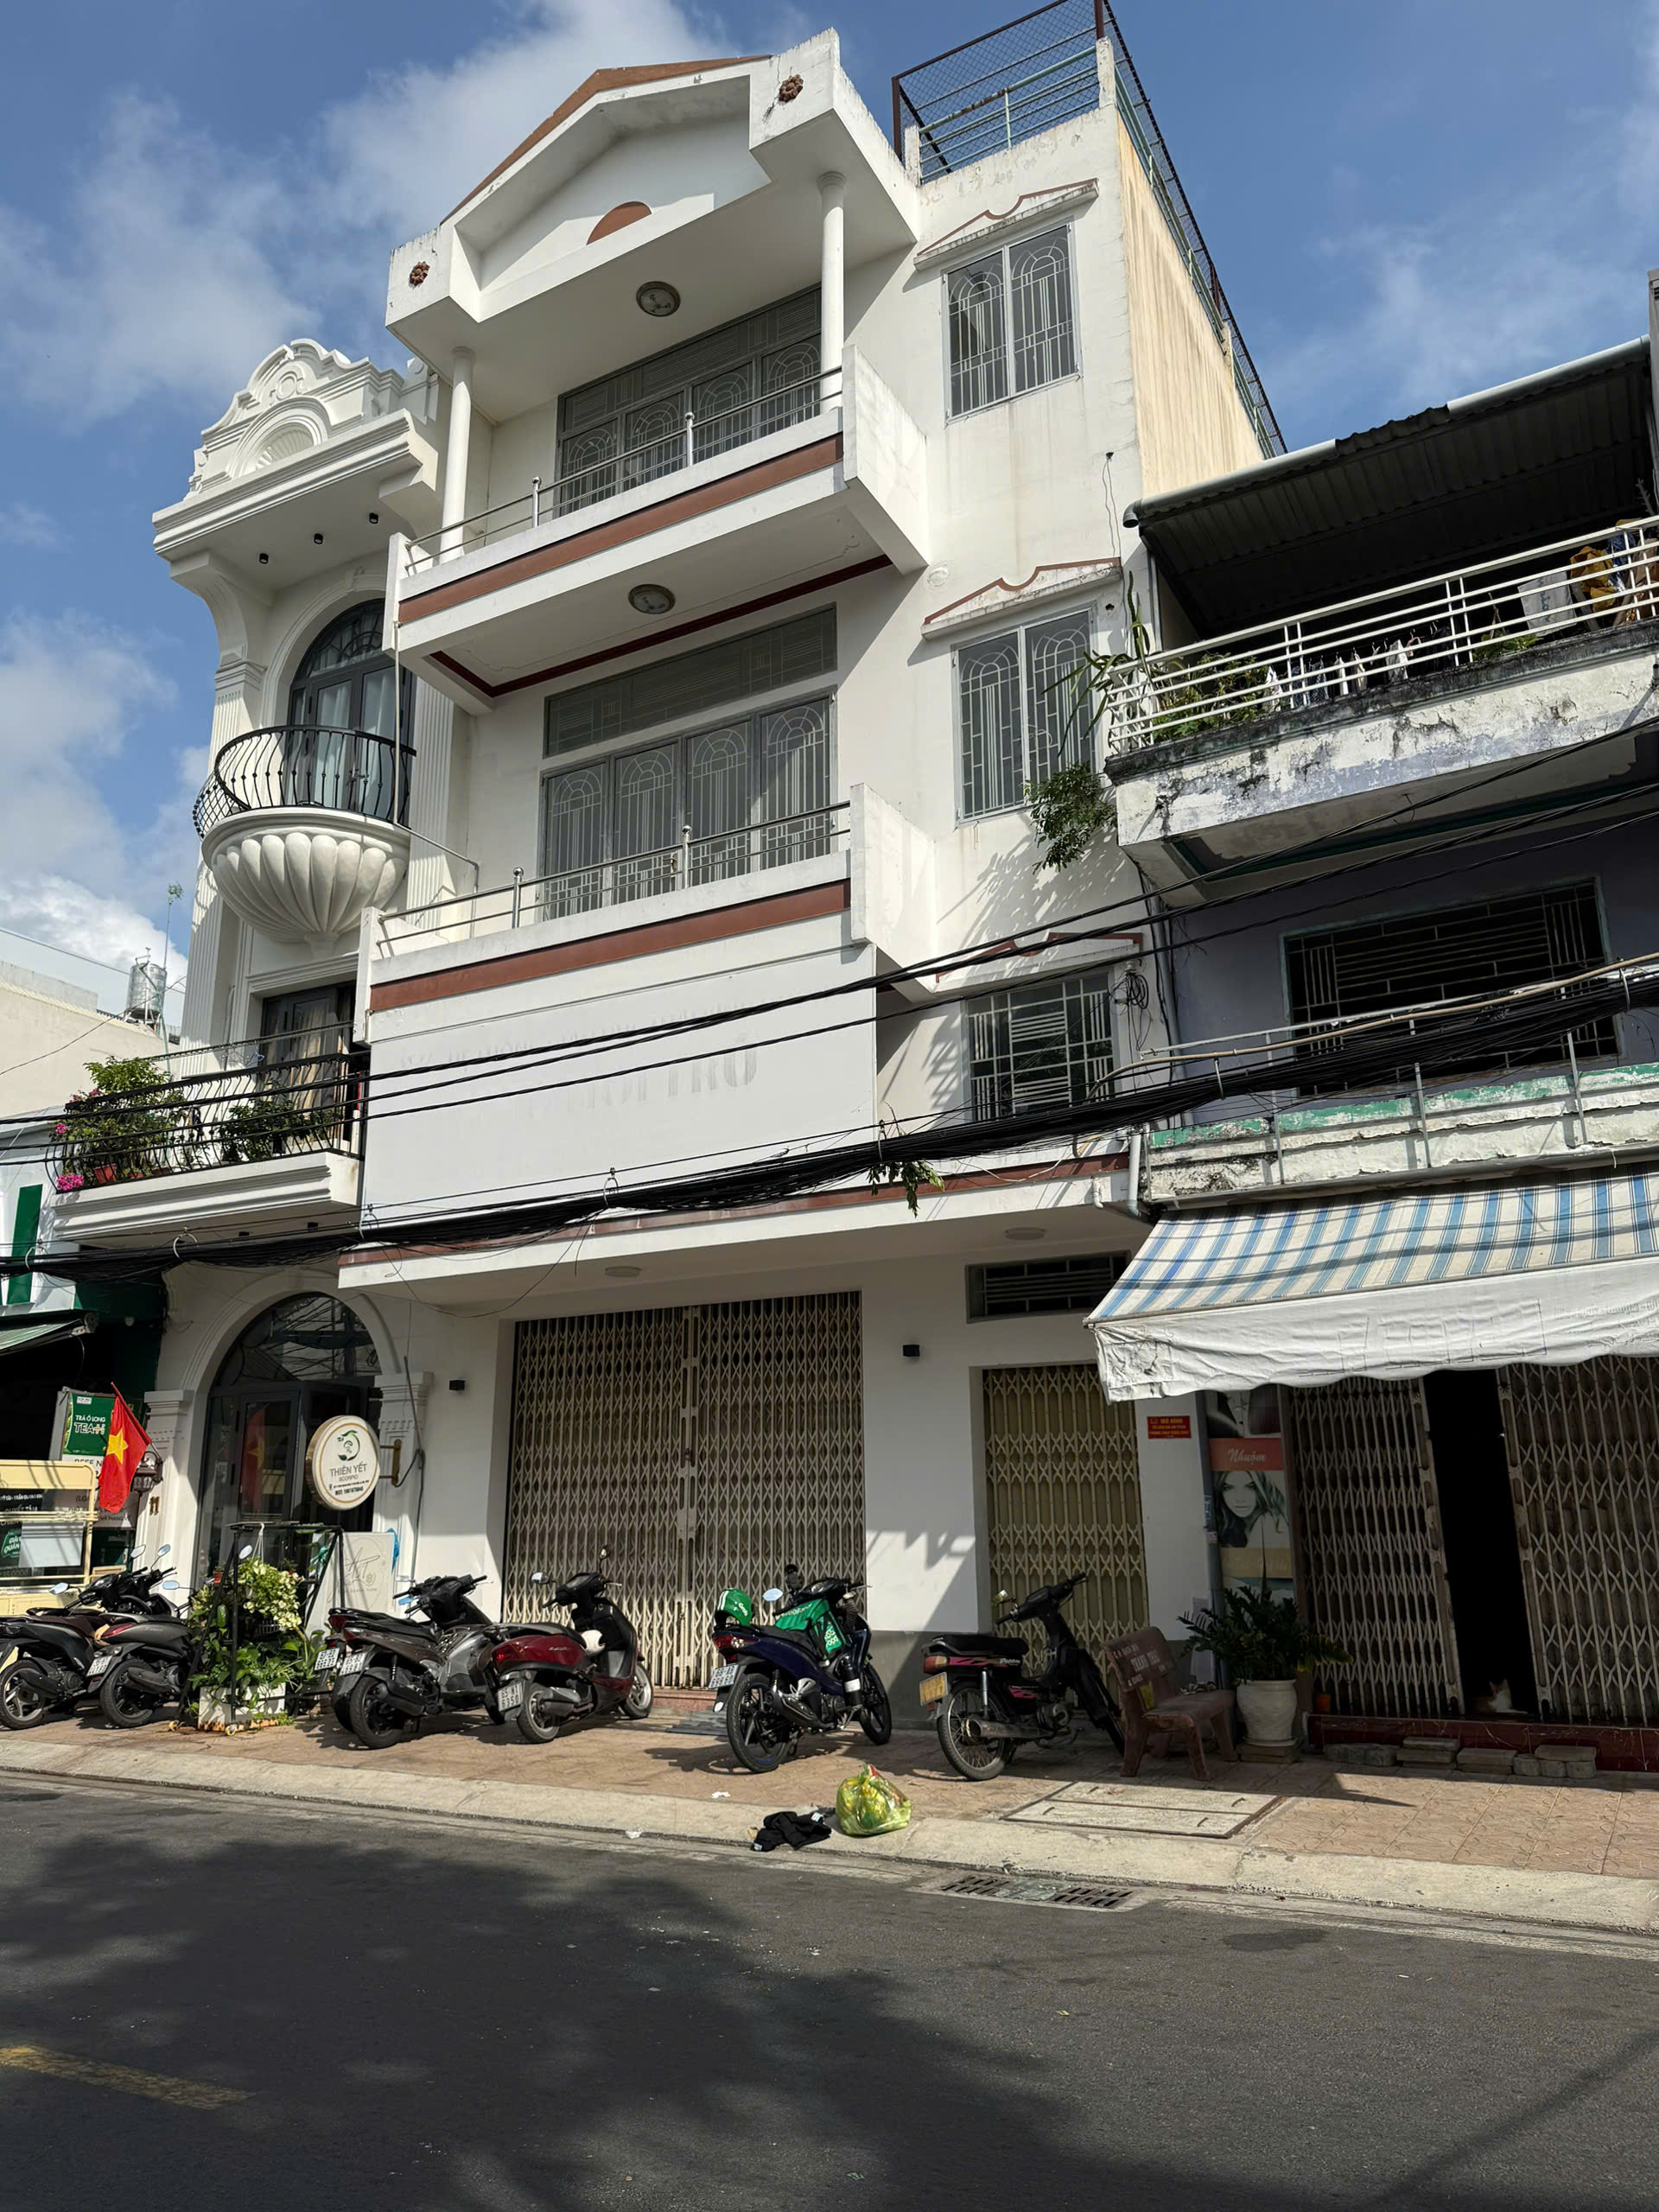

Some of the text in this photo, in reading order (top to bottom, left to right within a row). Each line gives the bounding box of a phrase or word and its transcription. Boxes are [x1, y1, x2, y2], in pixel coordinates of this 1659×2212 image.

[1228, 1448, 1266, 1466] Nhuộm
[329, 1461, 367, 1477] THIÊN YẾT
